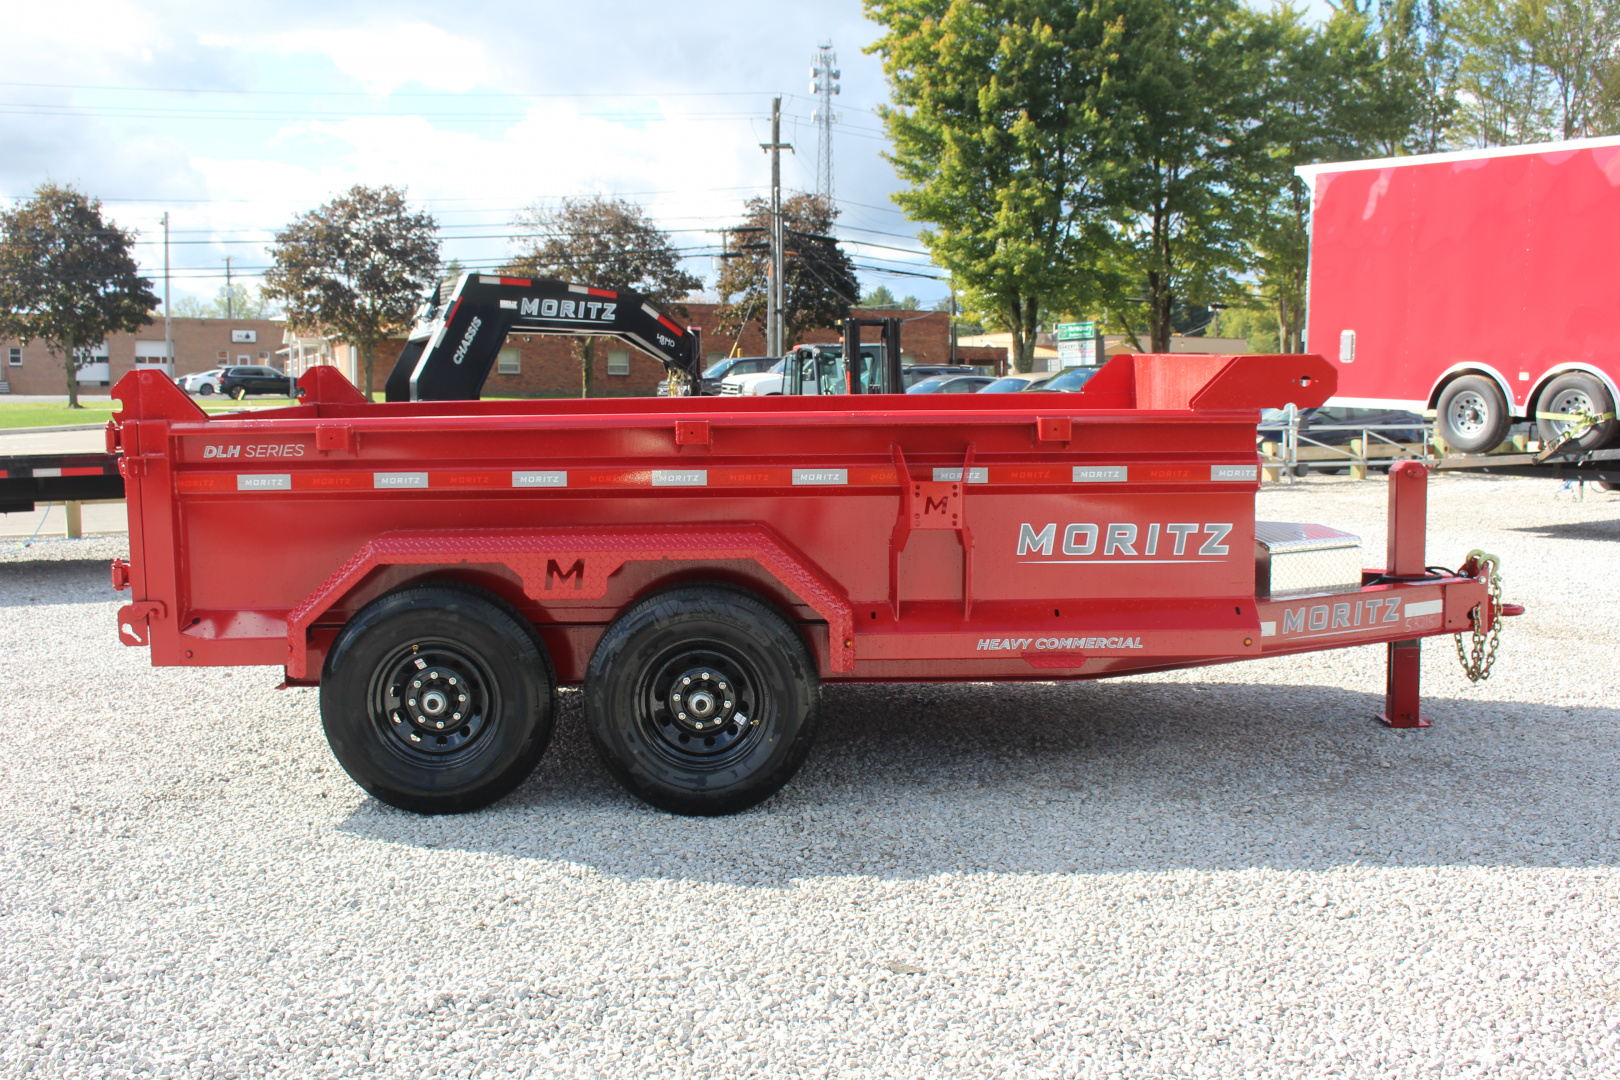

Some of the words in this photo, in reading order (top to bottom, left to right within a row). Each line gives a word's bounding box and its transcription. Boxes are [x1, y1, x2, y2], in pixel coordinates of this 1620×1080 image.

[520, 297, 617, 320] MORITZ
[453, 315, 483, 366] CHASSIS
[203, 445, 241, 458] DLH
[244, 444, 305, 457] SERIES
[800, 473, 840, 481] MORITZ
[1218, 469, 1257, 477] MORITZ
[924, 496, 948, 515] M
[1016, 523, 1233, 556] MORITZ
[544, 558, 585, 590] M
[1282, 597, 1402, 634] MORITZ
[976, 638, 1033, 650] HEAVY
[1035, 637, 1143, 650] COMMERCIAL
